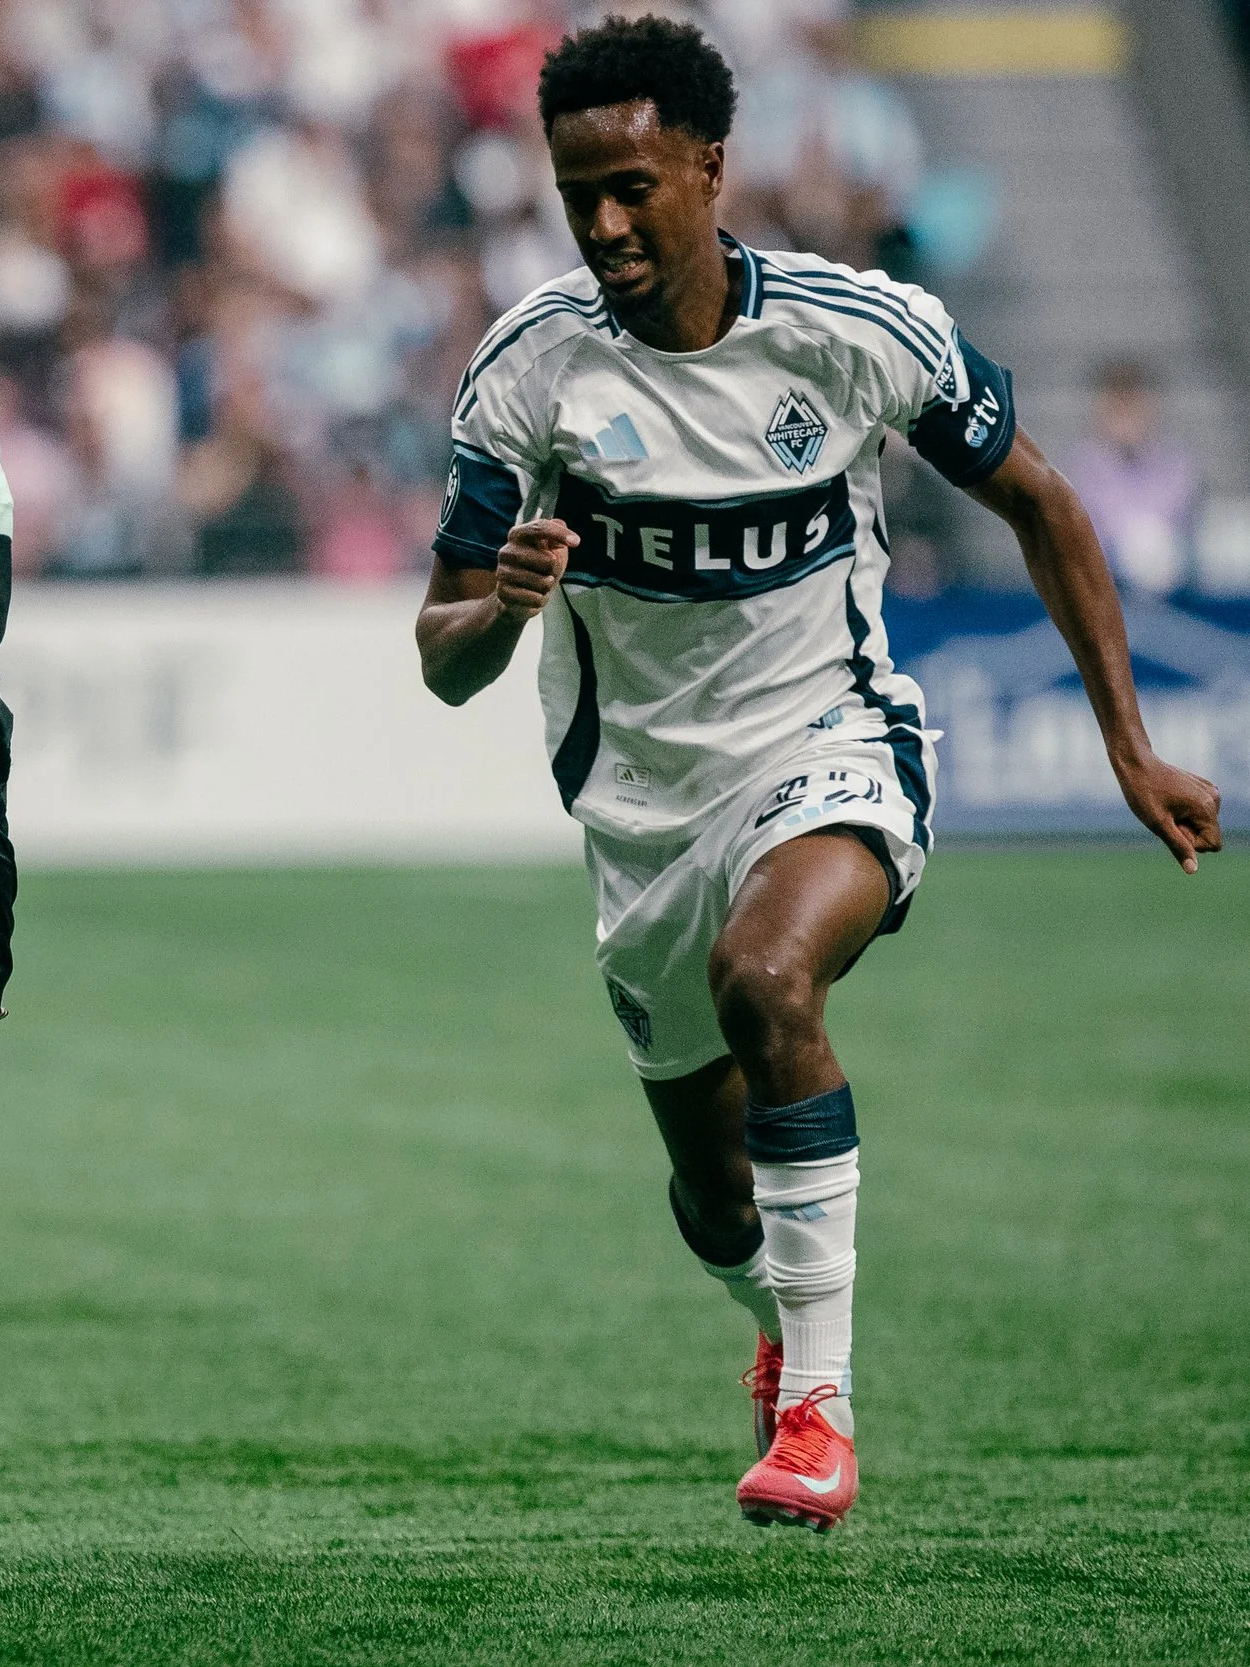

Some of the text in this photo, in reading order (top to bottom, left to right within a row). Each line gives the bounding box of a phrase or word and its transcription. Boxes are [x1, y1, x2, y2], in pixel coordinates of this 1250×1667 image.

[937, 363, 953, 387] MLS
[973, 386, 1000, 426] tv
[767, 426, 825, 442] WHITECAPS
[778, 421, 813, 430] VANCOUVER
[791, 439, 803, 448] FC
[591, 501, 830, 571] TELUS
